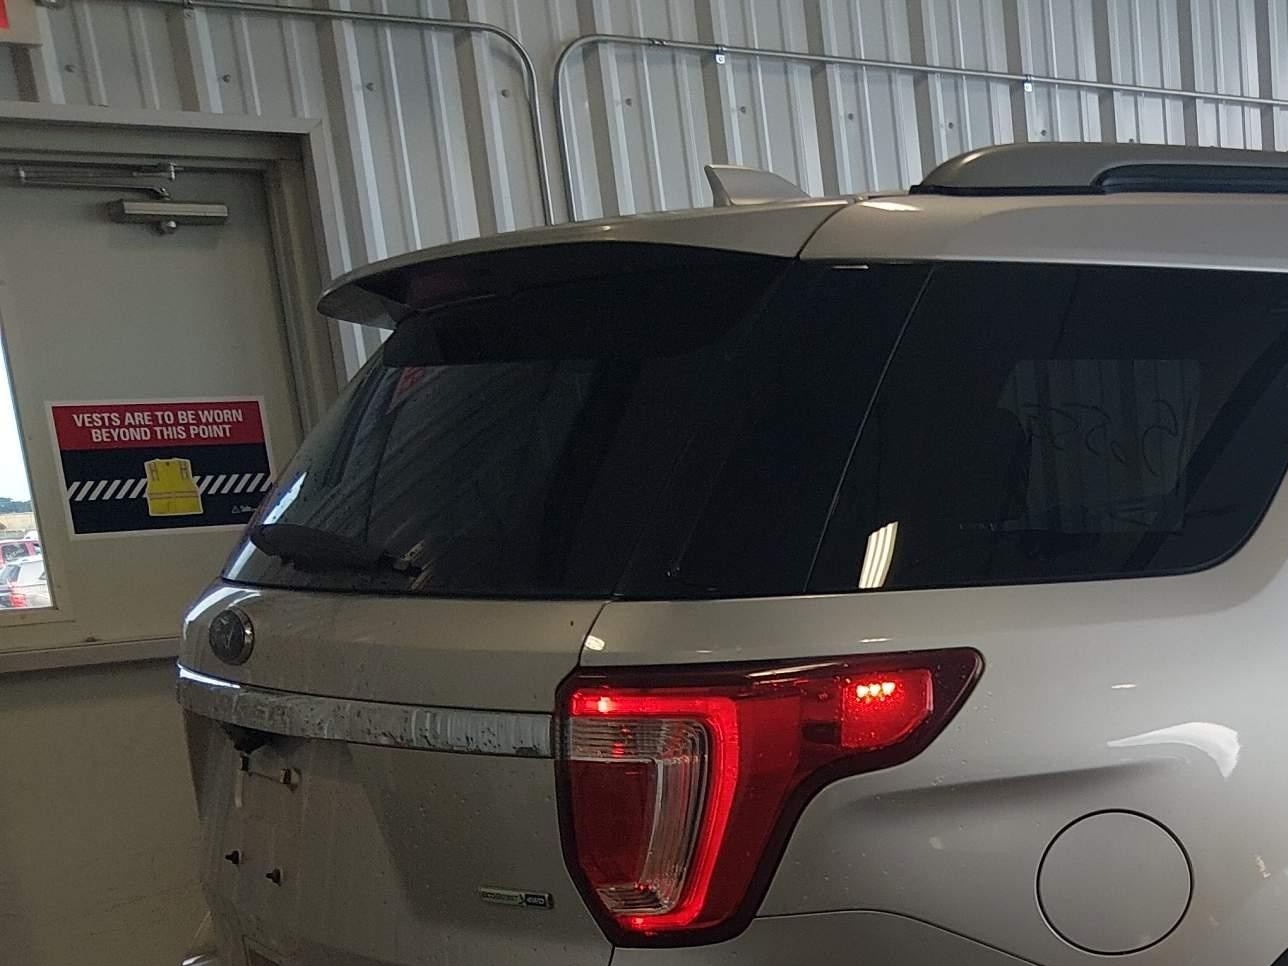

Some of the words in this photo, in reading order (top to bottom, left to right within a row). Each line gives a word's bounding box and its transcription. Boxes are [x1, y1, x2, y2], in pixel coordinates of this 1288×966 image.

[72, 413, 121, 427] VESTS
[124, 412, 153, 426] ARE
[155, 411, 175, 425] TO
[178, 411, 197, 424] BE
[199, 409, 243, 423] WORN
[91, 427, 151, 442] BEYOND
[154, 426, 186, 440] THIS
[190, 425, 232, 438] POINT
